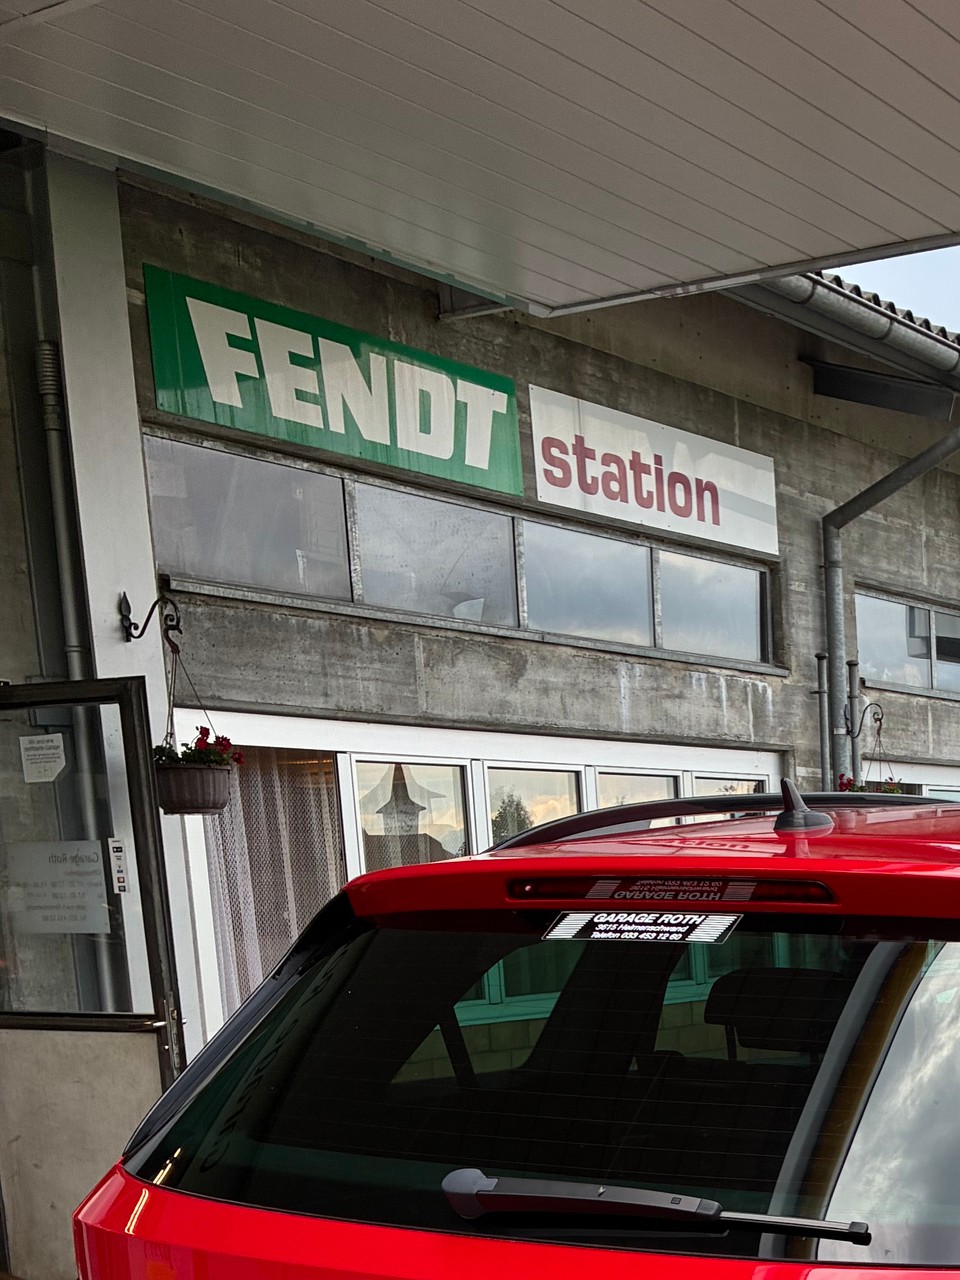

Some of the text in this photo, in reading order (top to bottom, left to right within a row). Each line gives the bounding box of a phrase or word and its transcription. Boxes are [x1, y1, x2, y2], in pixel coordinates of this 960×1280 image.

[185, 296, 508, 470] FENDT
[540, 433, 721, 526] station
[593, 913, 706, 925] GARAGE ROTH
